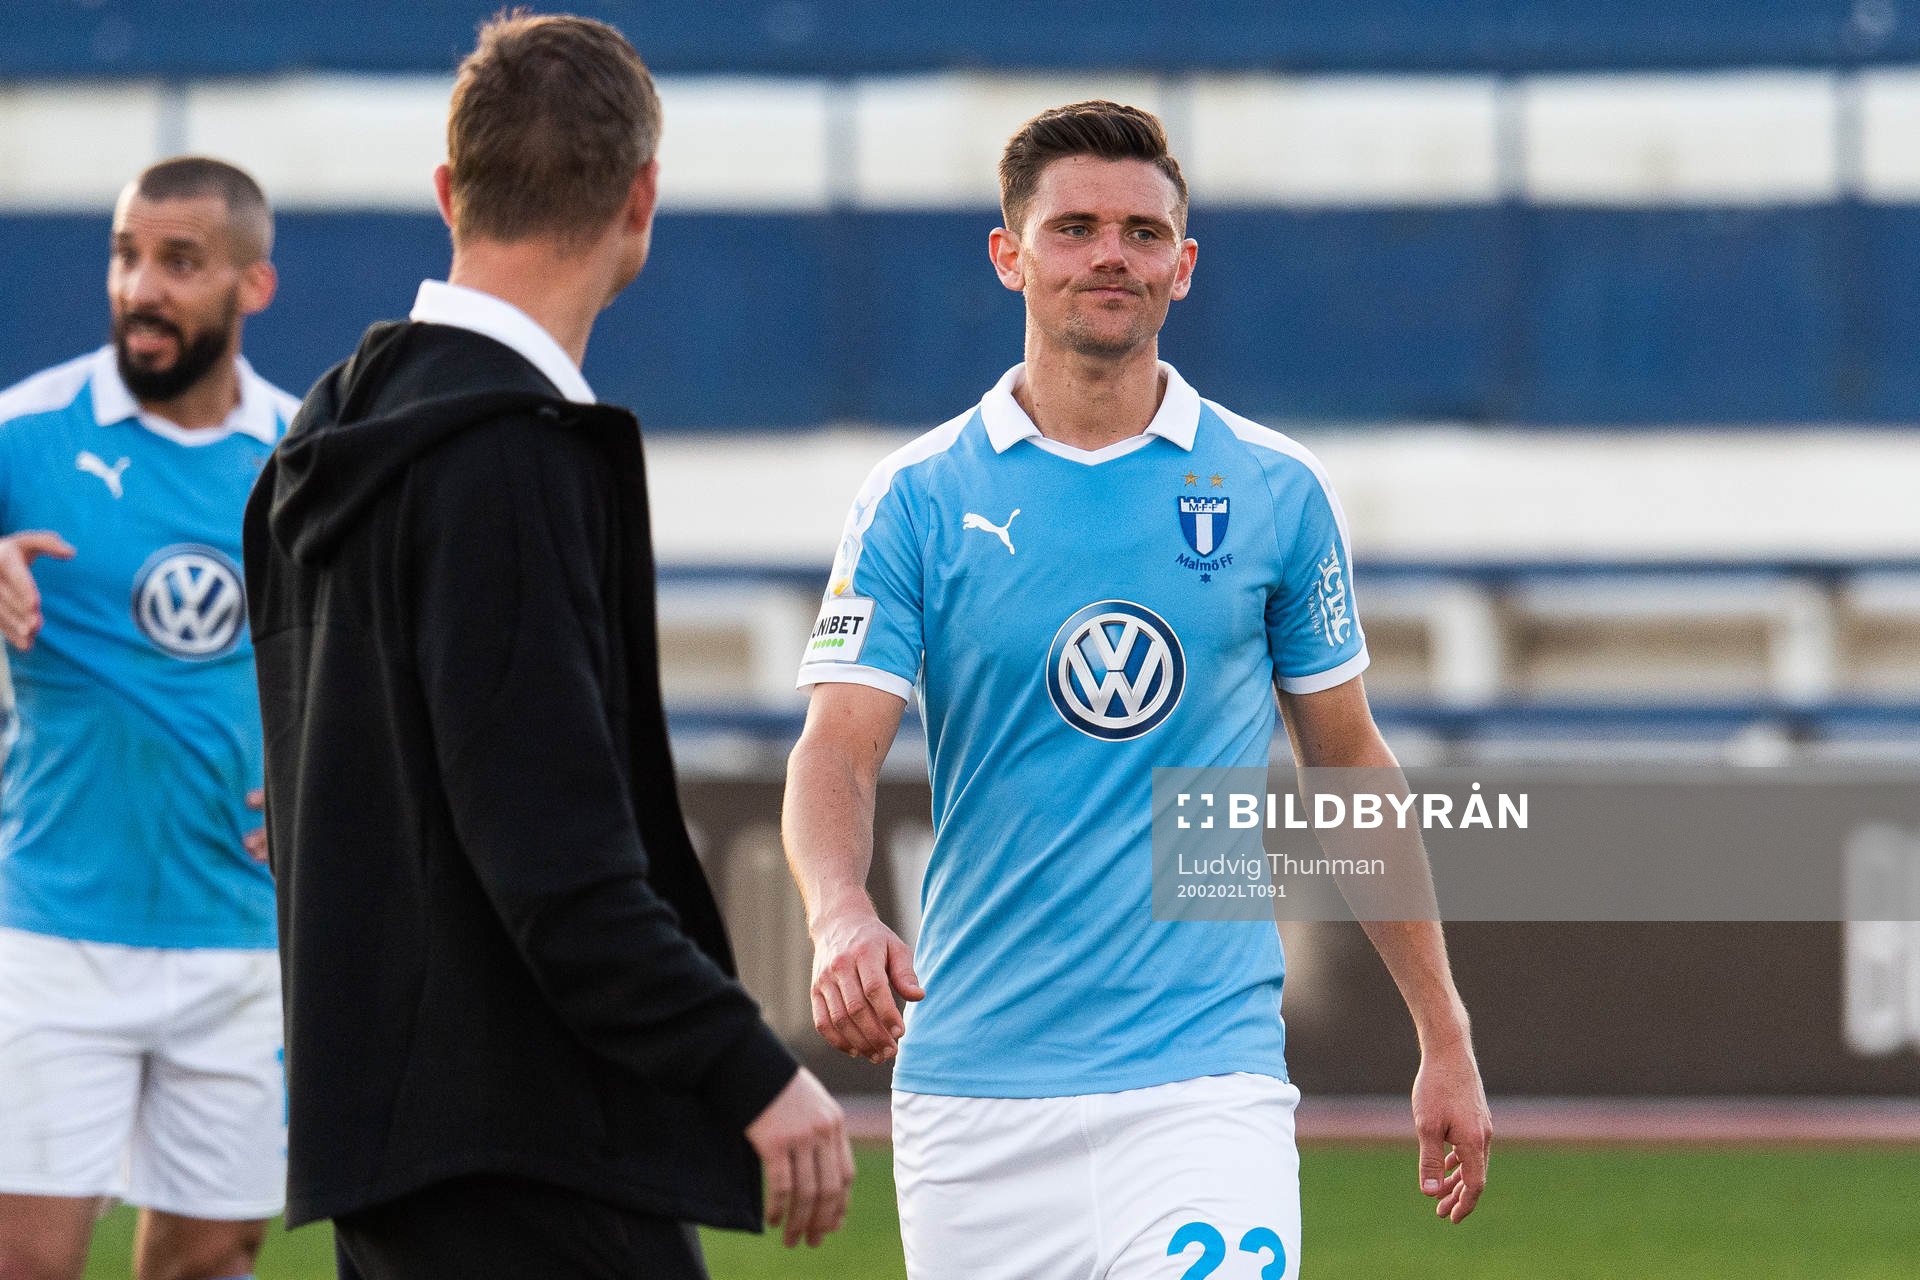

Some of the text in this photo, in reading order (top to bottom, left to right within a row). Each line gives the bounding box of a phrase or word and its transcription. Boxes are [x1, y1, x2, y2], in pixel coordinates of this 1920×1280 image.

[1176, 552, 1234, 572] Malmö FF
[812, 616, 864, 639] NIBET
[1058, 612, 1174, 729] VW
